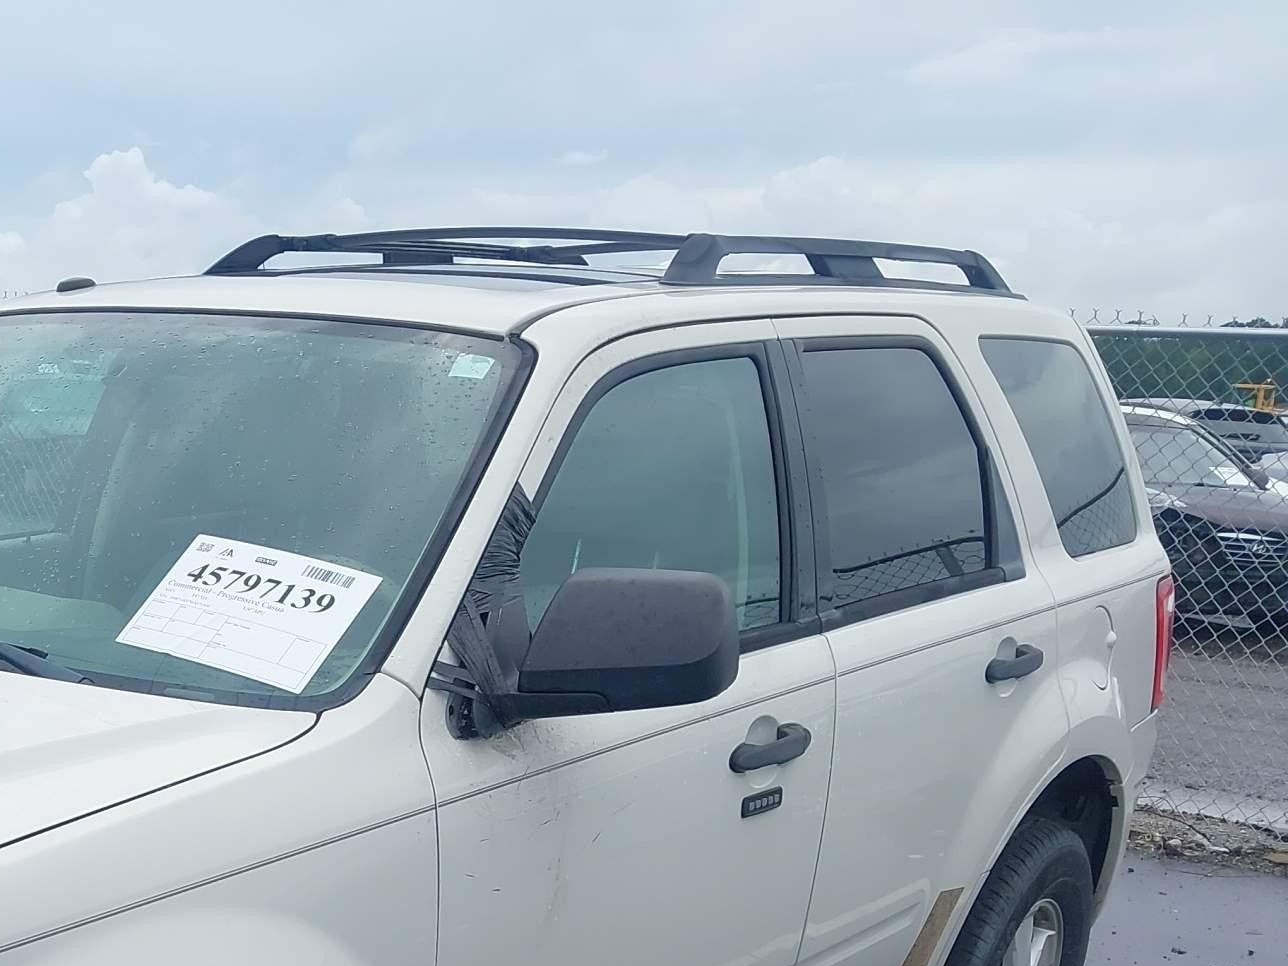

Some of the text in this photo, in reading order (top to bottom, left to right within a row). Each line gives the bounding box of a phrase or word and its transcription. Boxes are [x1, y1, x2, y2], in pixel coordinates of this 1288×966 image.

[168, 579, 212, 594] Commercial
[217, 590, 261, 606] Progressive
[187, 563, 336, 613] 45797139
